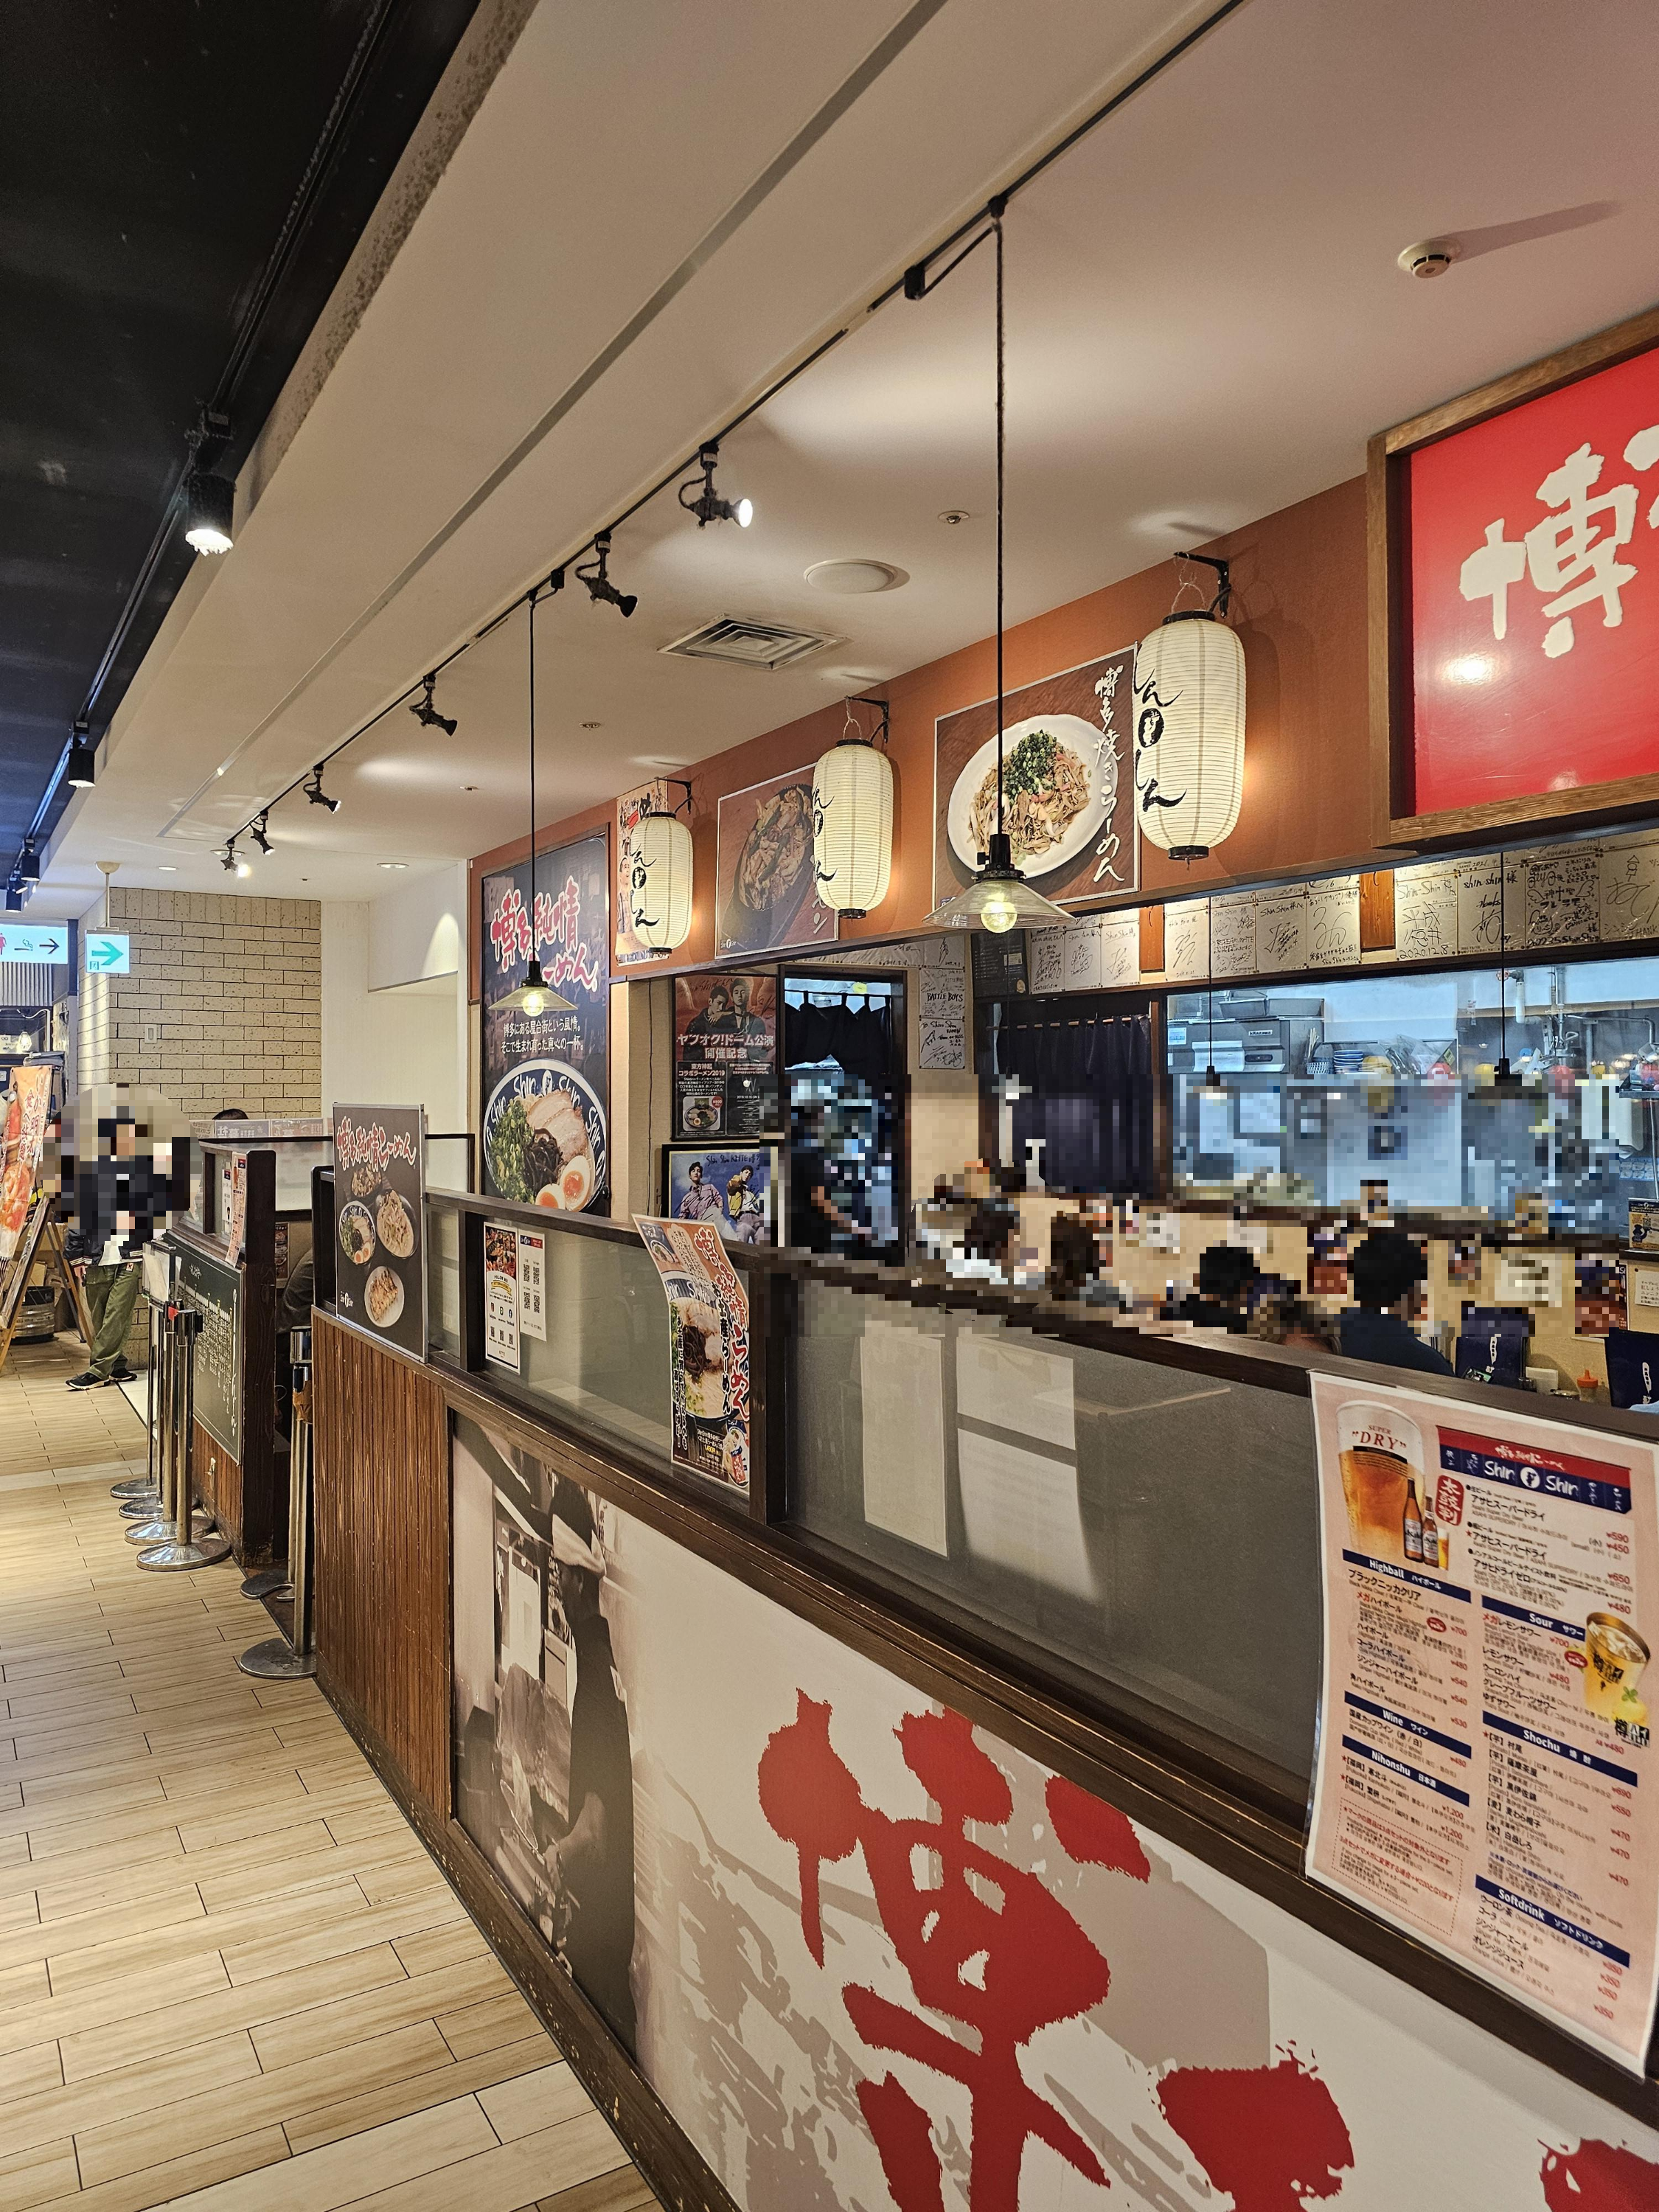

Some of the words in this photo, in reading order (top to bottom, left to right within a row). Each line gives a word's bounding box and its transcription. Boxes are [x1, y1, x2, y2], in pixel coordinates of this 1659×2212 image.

[1093, 664, 1126, 883] 博多焼きらーめん
[1399, 945, 1449, 960] 2020.12.8
[501, 1034, 583, 1055] そこで生まれ育った真心の一杯。
[705, 1047, 748, 1059] 開催記念
[513, 1074, 537, 1096] Shin
[1368, 1425, 1392, 1435] SUPER
[1484, 1461, 1514, 1481] Shin
[1545, 1475, 1578, 1496] Shin
[1471, 1494, 1546, 1522] アサヒスーパードライ
[1348, 1569, 1421, 1601] ブラックニッカクリア
[1369, 1559, 1405, 1579] Highball
[1411, 1575, 1441, 1590] ハイボール
[1357, 1592, 1402, 1613] メガハイボール
[1357, 1623, 1389, 1640] ハイボール
[1482, 1613, 1542, 1637] メガレモンサワー
[1528, 1613, 1554, 1629] Sour
[1562, 1624, 1584, 1636] サワー
[1357, 1638, 1405, 1663] コーラハイボール
[1482, 1646, 1524, 1666] レモンサワー
[1357, 1653, 1419, 1686] ジンジャーハイボール
[1483, 1663, 1521, 1683] ウーロンハイ
[1350, 1672, 1386, 1694] 角ハイボール
[1483, 1677, 1557, 1711] グレープフルーツサワー
[1483, 1692, 1517, 1710] ゆずサワー
[1349, 1708, 1394, 1733] 国産カップワイン
[1382, 1709, 1404, 1727] Wine
[1411, 1722, 1429, 1736] ワイン
[1523, 1730, 1561, 1753] Shochu
[1371, 1750, 1411, 1777] Nihonshu
[1418, 1773, 1436, 1789] 日本酒
[1478, 1906, 1498, 1920] コーラ
[1481, 1895, 1513, 1917] ウーロン茶
[1498, 1889, 1545, 1921] Softdrink
[1554, 1919, 1604, 1950] ソフトドリンク
[1475, 1917, 1528, 1951] ジンジャーエール
[1472, 1935, 1524, 1969] オレンジジュース
